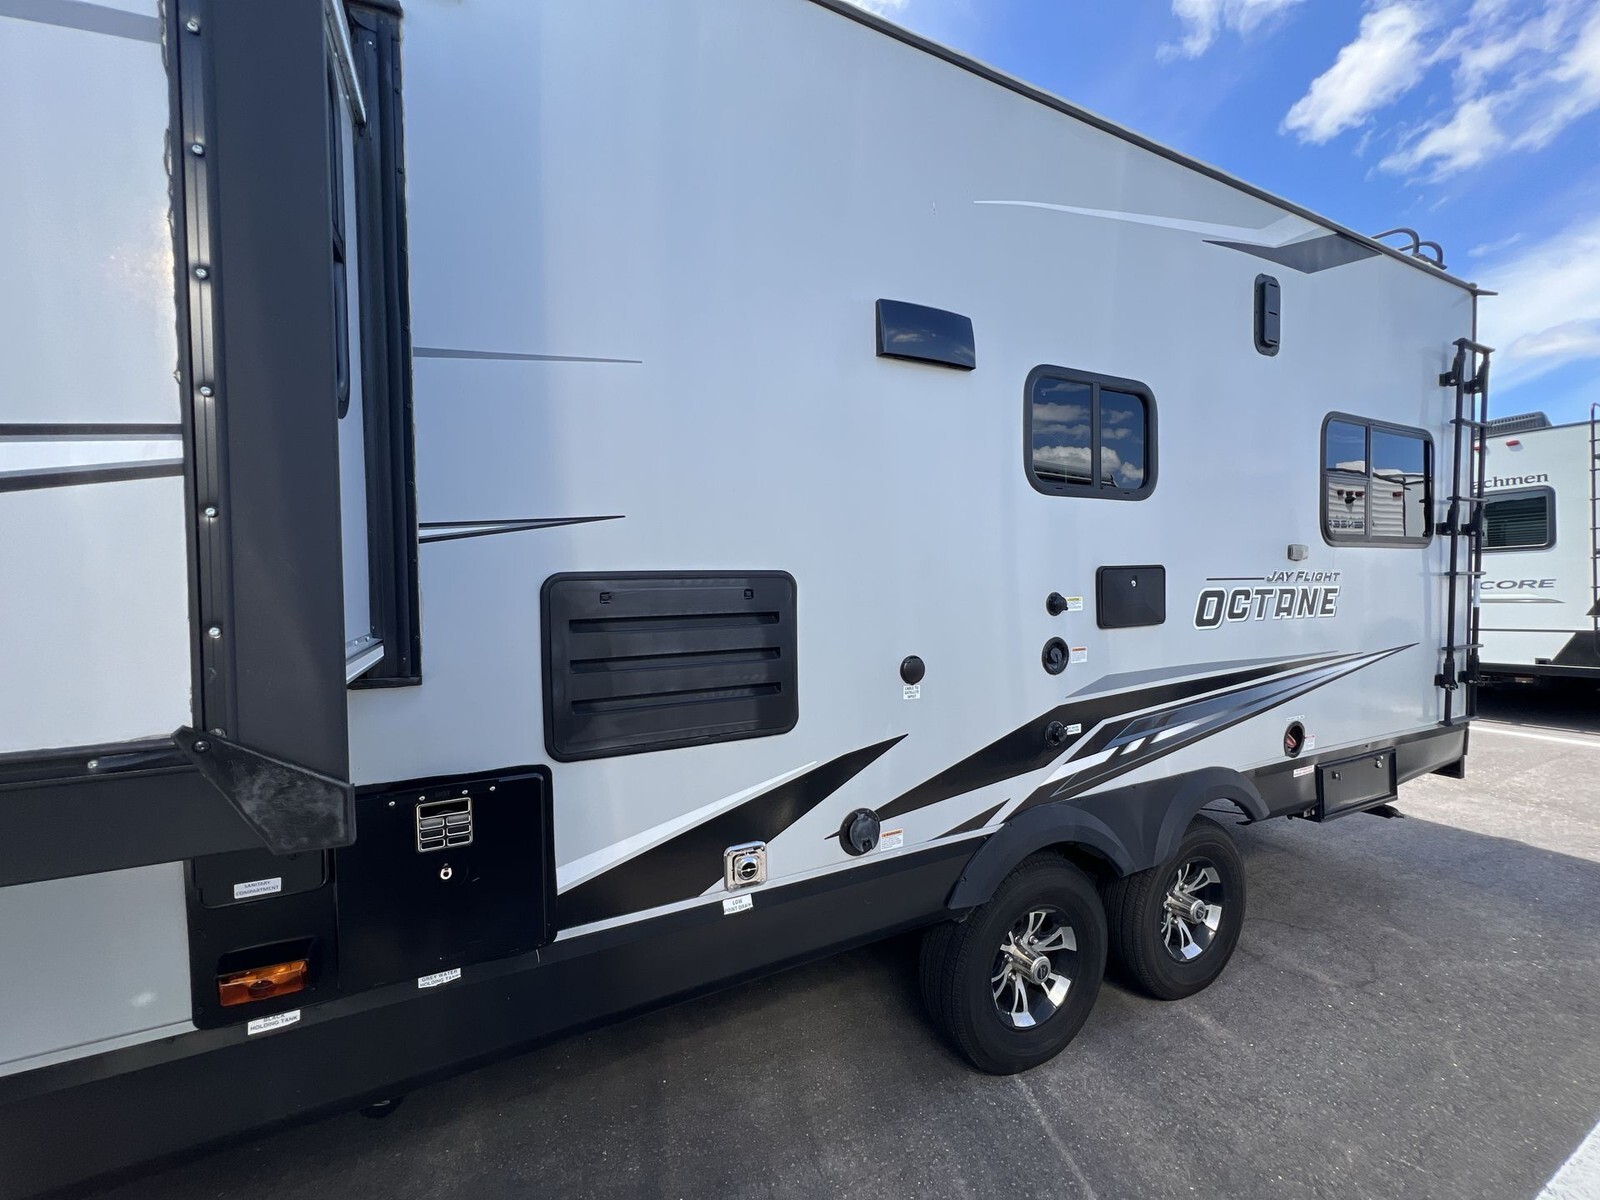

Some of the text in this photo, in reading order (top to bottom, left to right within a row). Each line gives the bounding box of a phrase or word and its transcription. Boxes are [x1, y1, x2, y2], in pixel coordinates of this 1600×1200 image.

[1266, 571, 1340, 582] JAY FLIGHT
[1194, 586, 1340, 630] OCTANE
[236, 885, 279, 896] COMPARTMENT
[250, 1015, 298, 1030] HOLDING TANK
